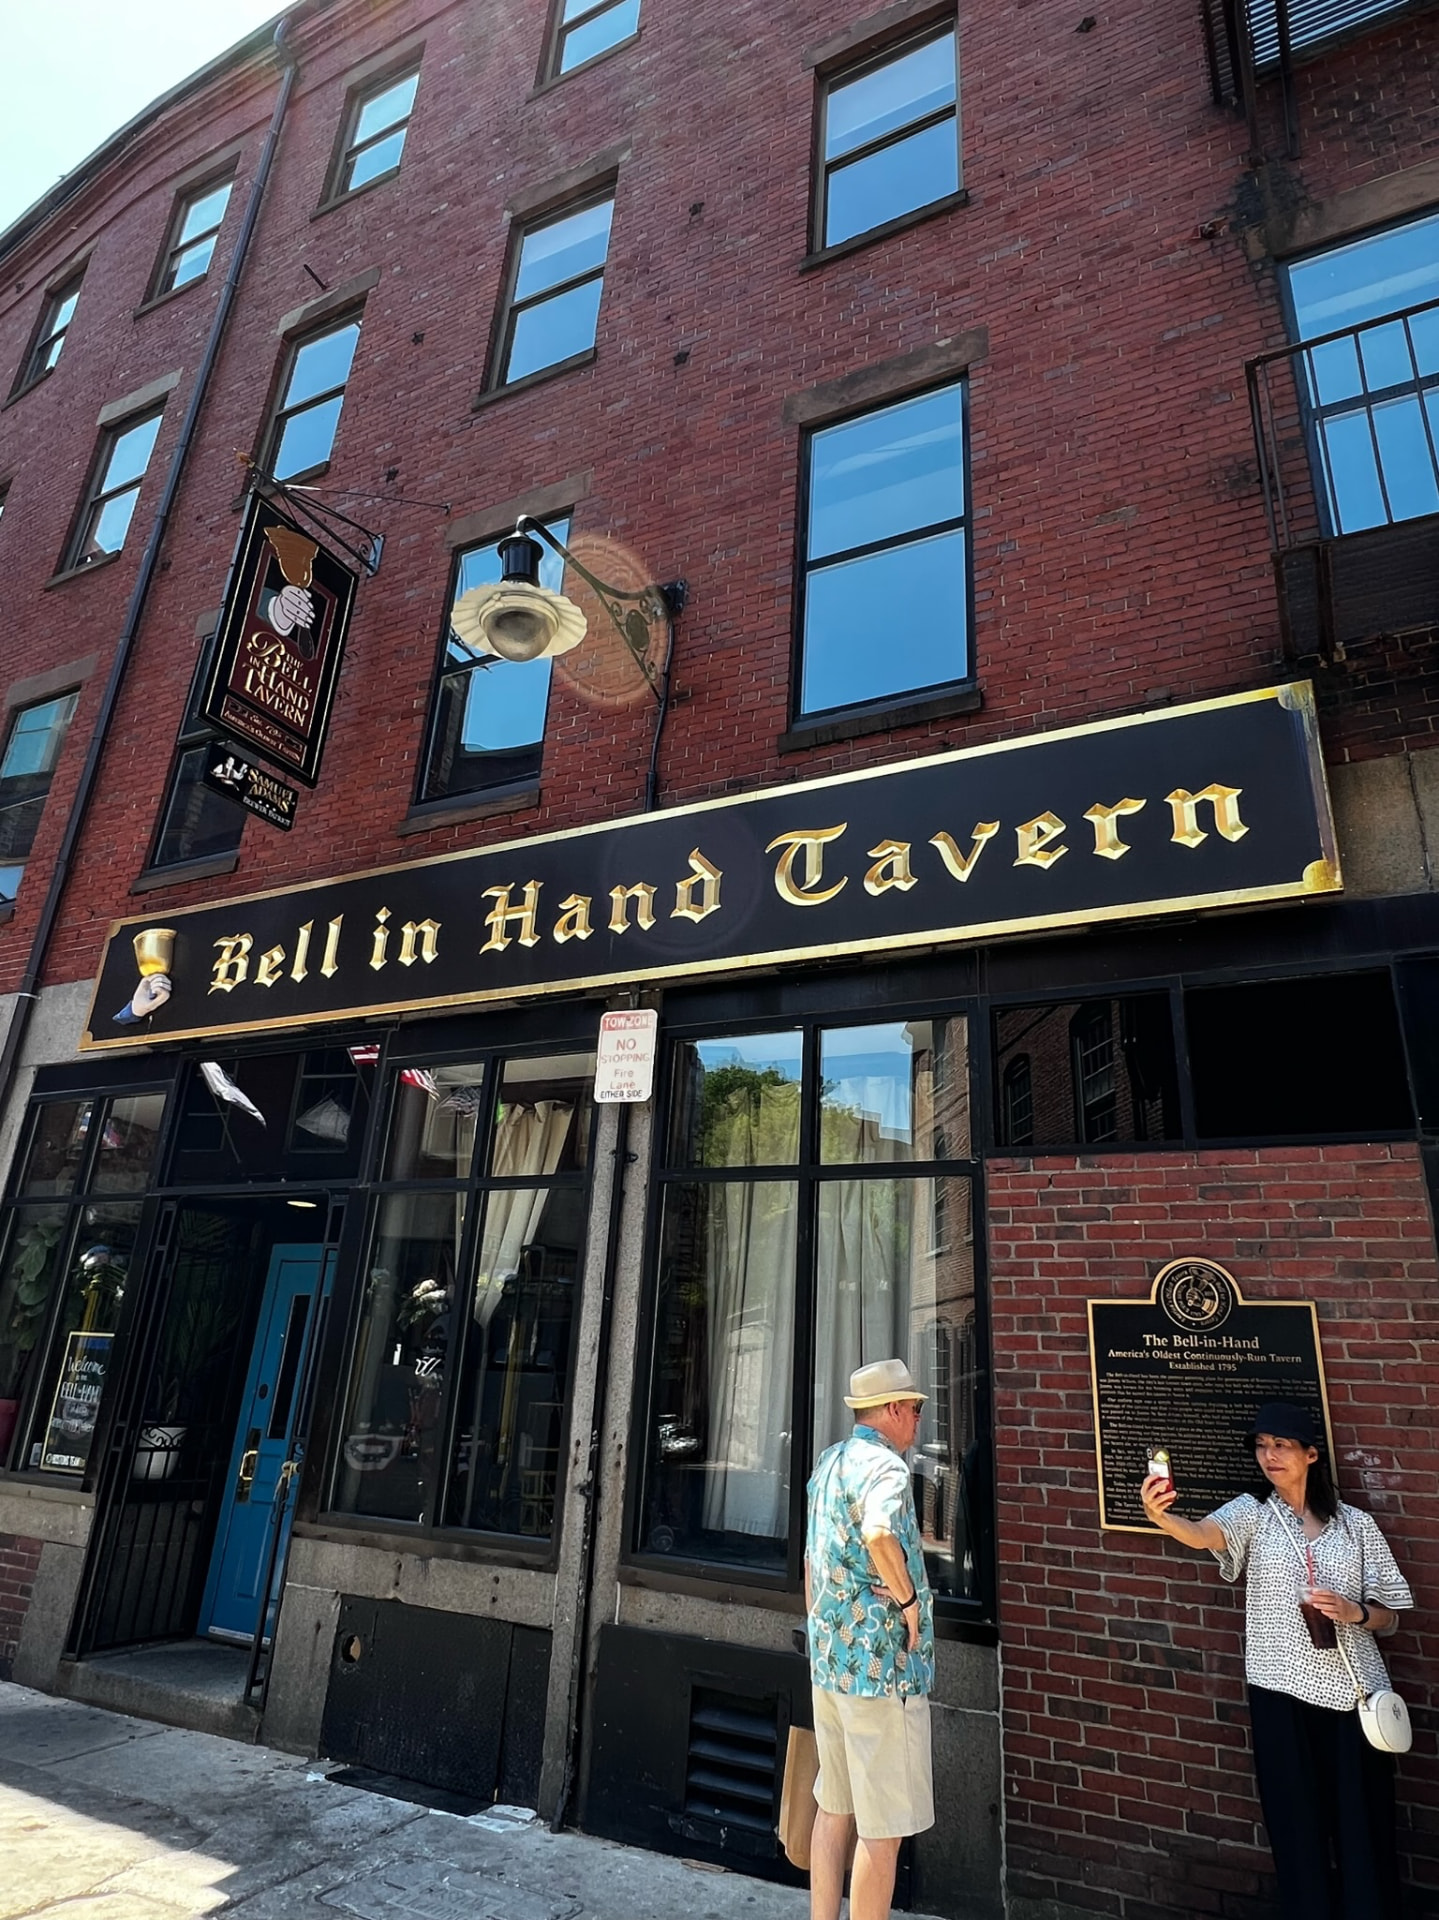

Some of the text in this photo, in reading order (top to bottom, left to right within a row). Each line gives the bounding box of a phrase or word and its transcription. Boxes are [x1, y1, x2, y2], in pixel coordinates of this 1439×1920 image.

[246, 631, 313, 693] BELL
[249, 655, 260, 668] IN
[242, 662, 306, 727] TAVERN
[258, 665, 309, 711] HAND
[248, 768, 296, 806] SAMUEL
[248, 784, 289, 813] ADAMS
[207, 782, 1251, 996] Bell in Hand Tavern
[616, 1038, 637, 1051] NO
[601, 1053, 650, 1065] STOPPING
[614, 1068, 634, 1079] Fire
[610, 1081, 636, 1091] Lane
[600, 1089, 643, 1099] EITHER SIDE
[1143, 1334, 1260, 1349] The Bell-in-Hand
[1108, 1349, 1302, 1363] America's Oldest Continuously-Run Tavern
[1169, 1361, 1238, 1372] Established 1795
